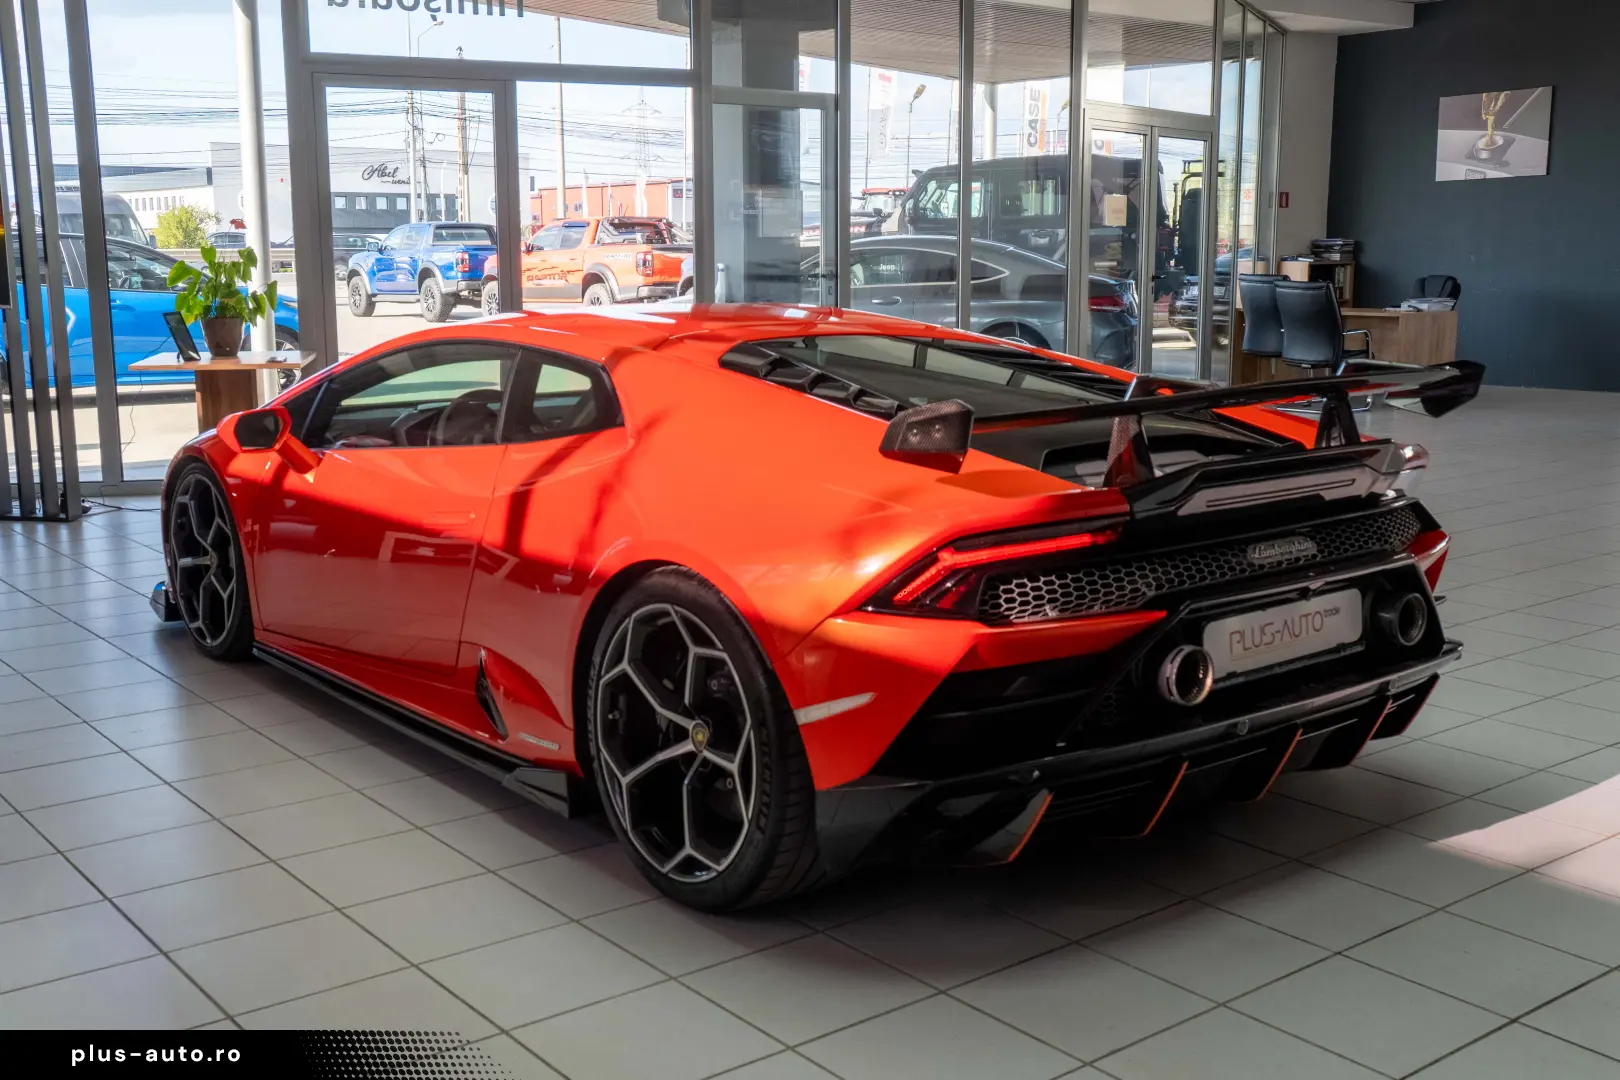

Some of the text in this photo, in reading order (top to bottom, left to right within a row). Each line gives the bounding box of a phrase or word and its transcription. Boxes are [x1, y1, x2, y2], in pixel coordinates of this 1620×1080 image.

[1026, 87, 1041, 148] CASE
[362, 163, 399, 181] Abel
[1251, 538, 1313, 558] Lamborghini
[1228, 609, 1324, 654] PLUS-AUTO
